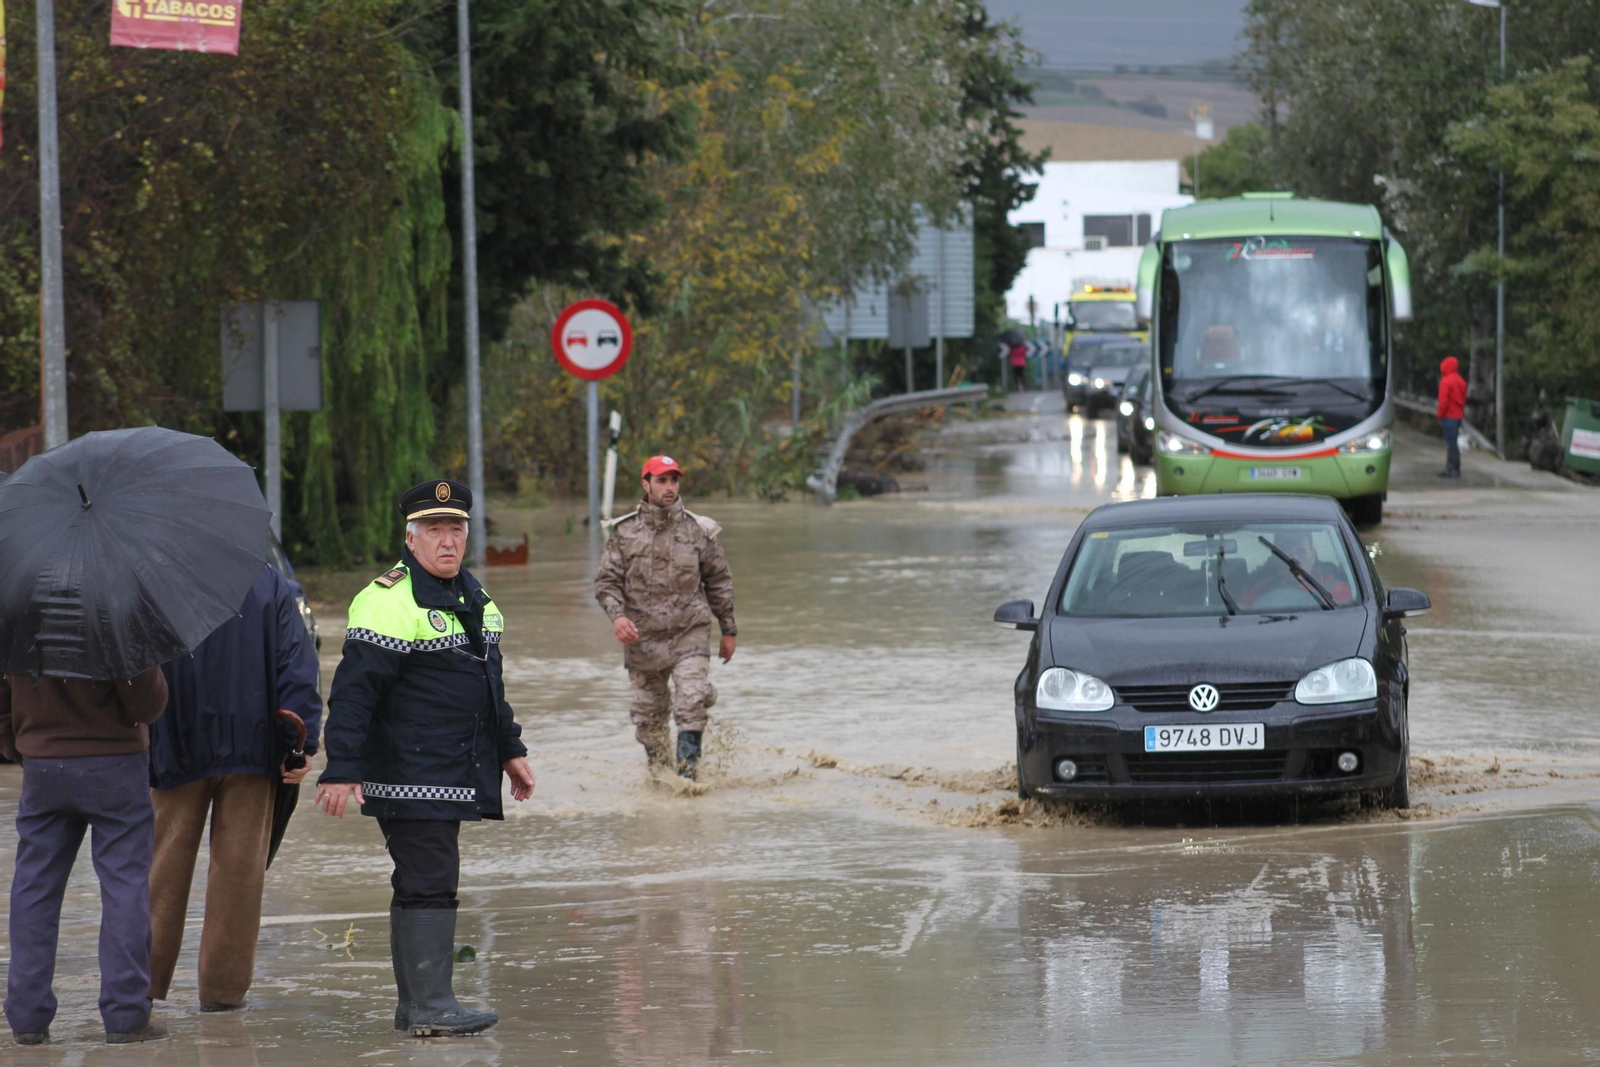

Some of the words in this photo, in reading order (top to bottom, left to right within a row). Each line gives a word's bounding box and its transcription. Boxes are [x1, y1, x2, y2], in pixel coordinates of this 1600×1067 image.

[144, 0, 236, 20] TABACOS
[1159, 728, 1211, 748] 9748
[1219, 727, 1258, 746] DVJ
